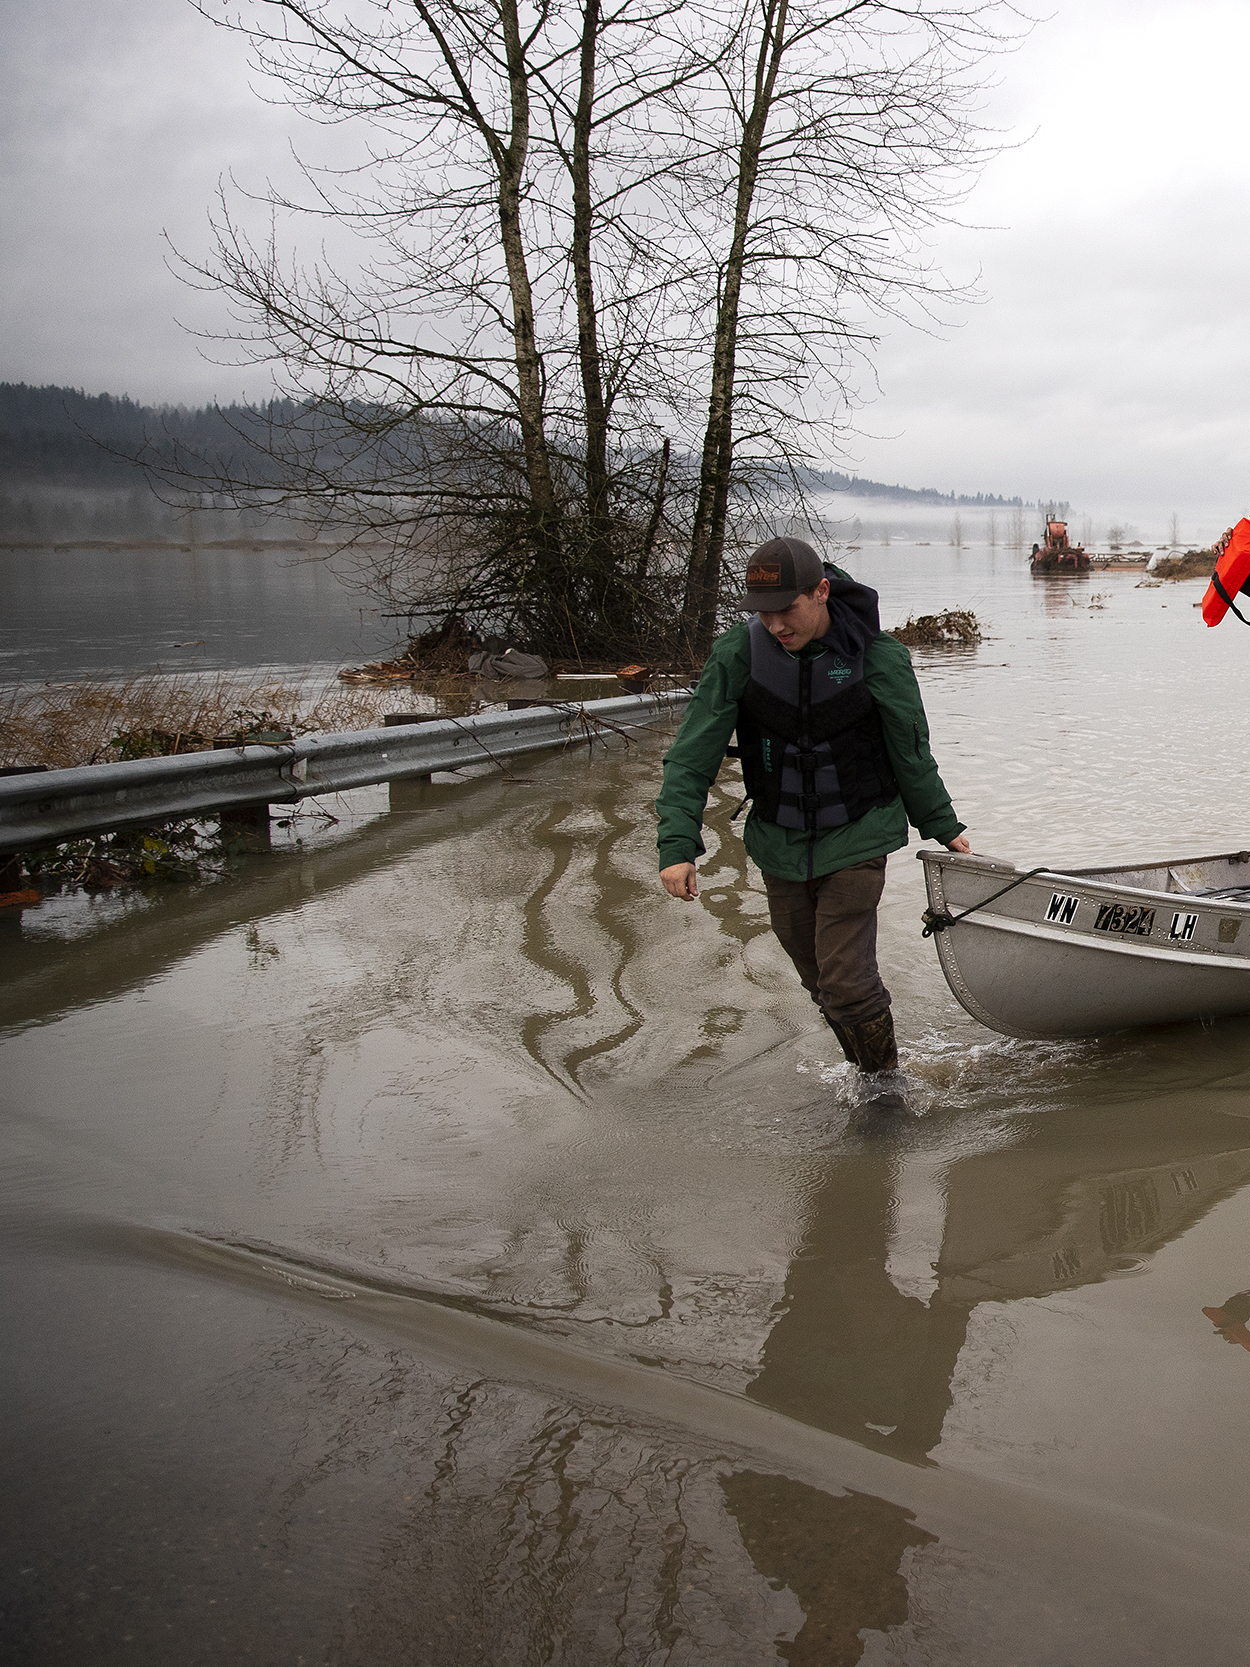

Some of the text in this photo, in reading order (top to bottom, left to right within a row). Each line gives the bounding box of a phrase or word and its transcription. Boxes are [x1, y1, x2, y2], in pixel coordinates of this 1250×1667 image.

[1046, 893, 1198, 941] WN 7324 LH
